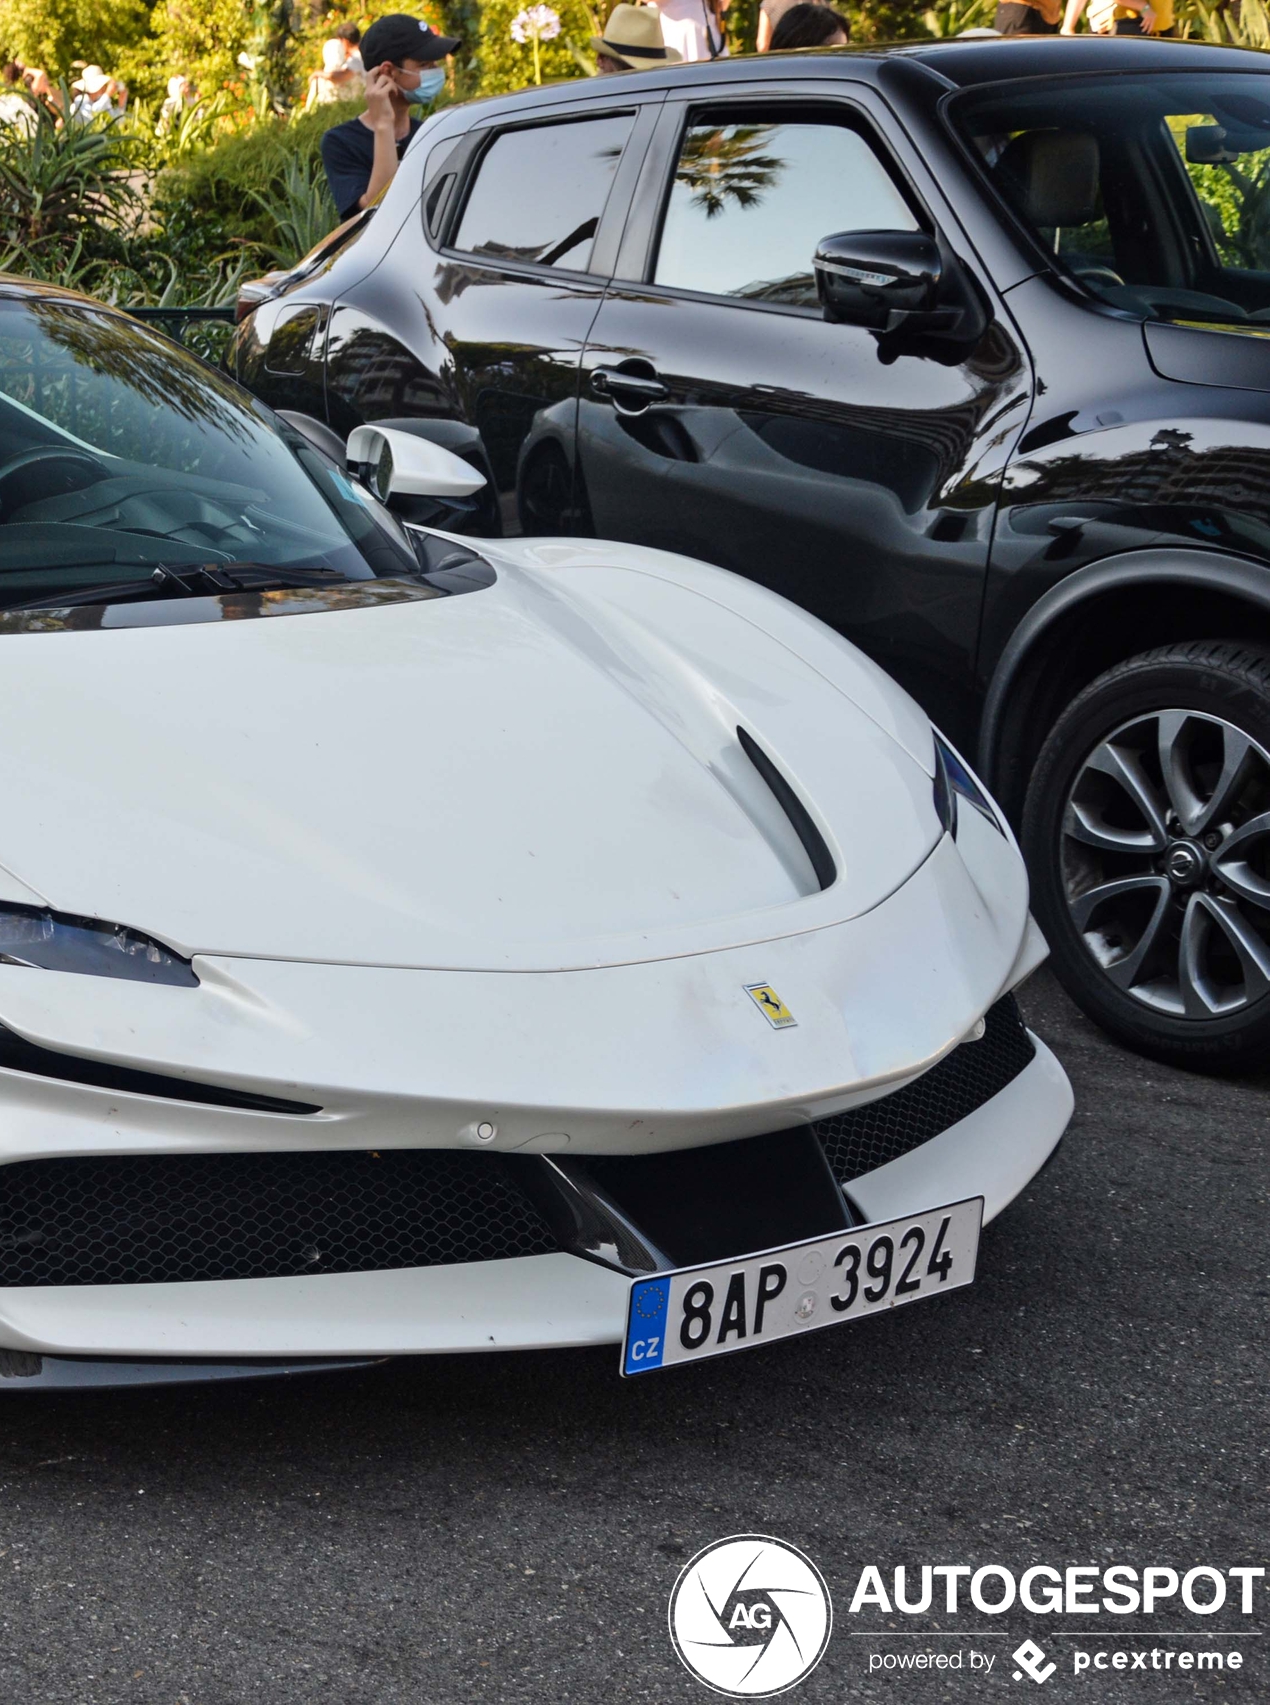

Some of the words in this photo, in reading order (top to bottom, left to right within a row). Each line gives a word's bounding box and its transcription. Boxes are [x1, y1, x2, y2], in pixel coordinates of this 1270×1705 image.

[680, 1262, 787, 1350] 8AP
[830, 1215, 953, 1312] 3924
[632, 1337, 658, 1361] CZ
